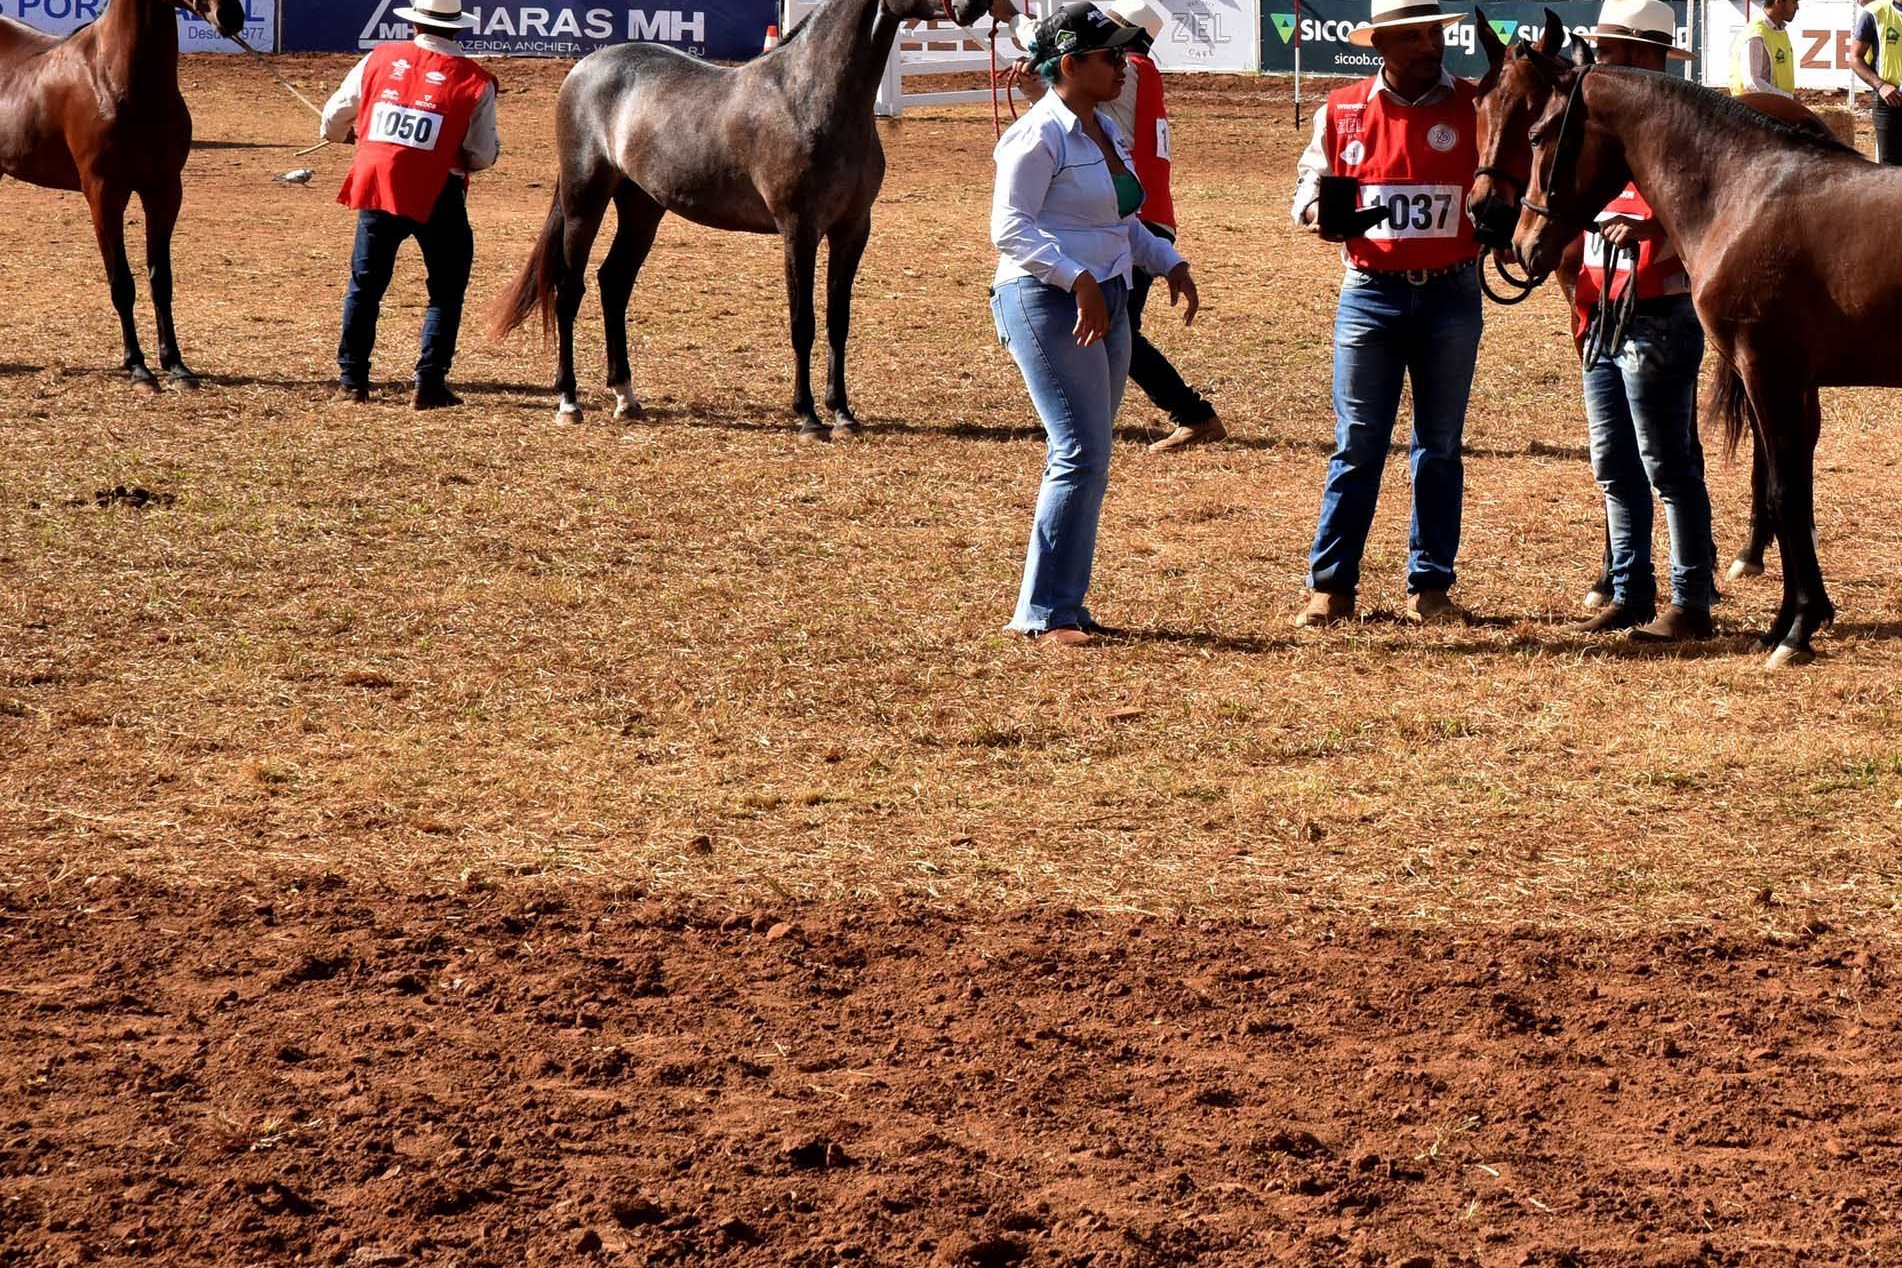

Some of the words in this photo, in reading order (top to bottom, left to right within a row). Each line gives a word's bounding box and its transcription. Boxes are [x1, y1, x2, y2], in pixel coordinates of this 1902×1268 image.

[628, 9, 704, 42] MH
[1172, 13, 1231, 43] ZEL
[1300, 19, 1371, 42] SICO
[458, 40, 511, 51] AZENDA
[515, 42, 581, 53] ANCHIETA
[1335, 53, 1385, 65] sicoob.co
[1800, 30, 1851, 69] ZE
[377, 110, 432, 143] 1050
[1370, 193, 1452, 230] 1037
